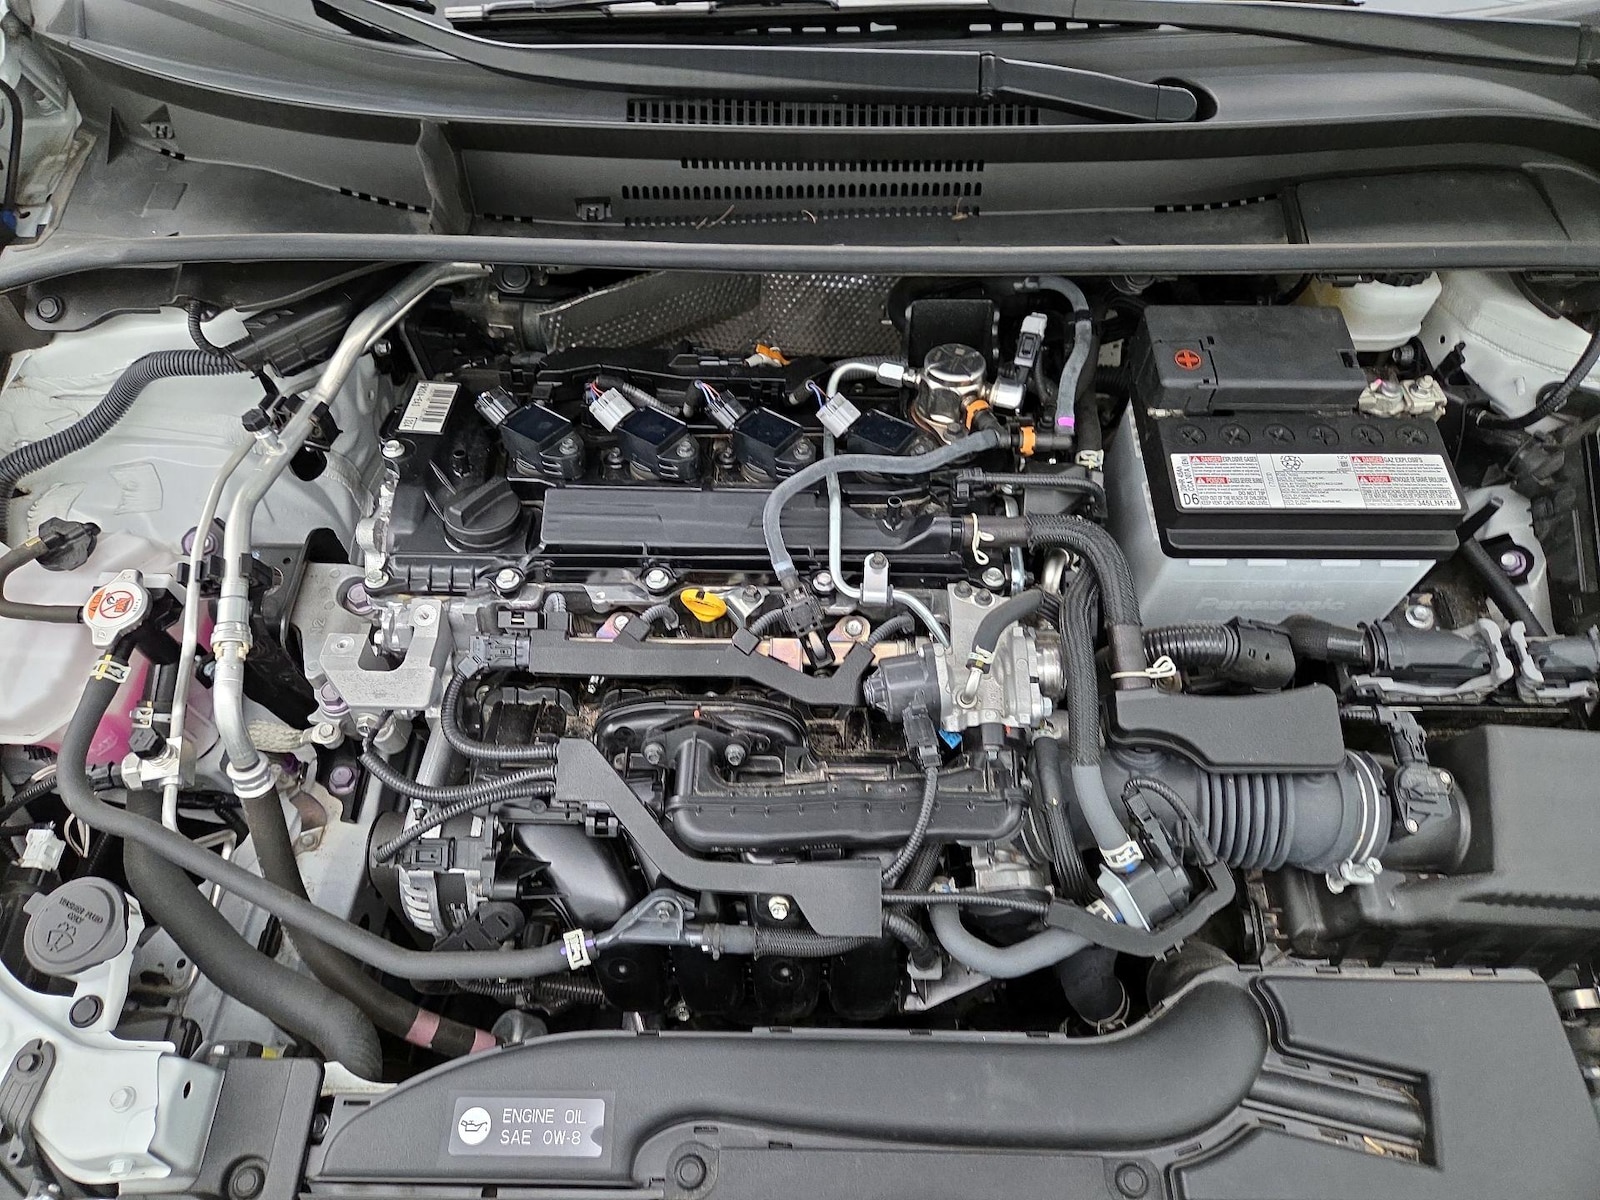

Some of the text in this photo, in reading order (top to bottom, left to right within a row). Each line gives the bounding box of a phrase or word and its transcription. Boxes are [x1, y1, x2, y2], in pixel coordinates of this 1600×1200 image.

[1183, 493, 1200, 505] D6
[502, 1108, 587, 1124] ENGINE OIL
[500, 1129, 533, 1145] SAE
